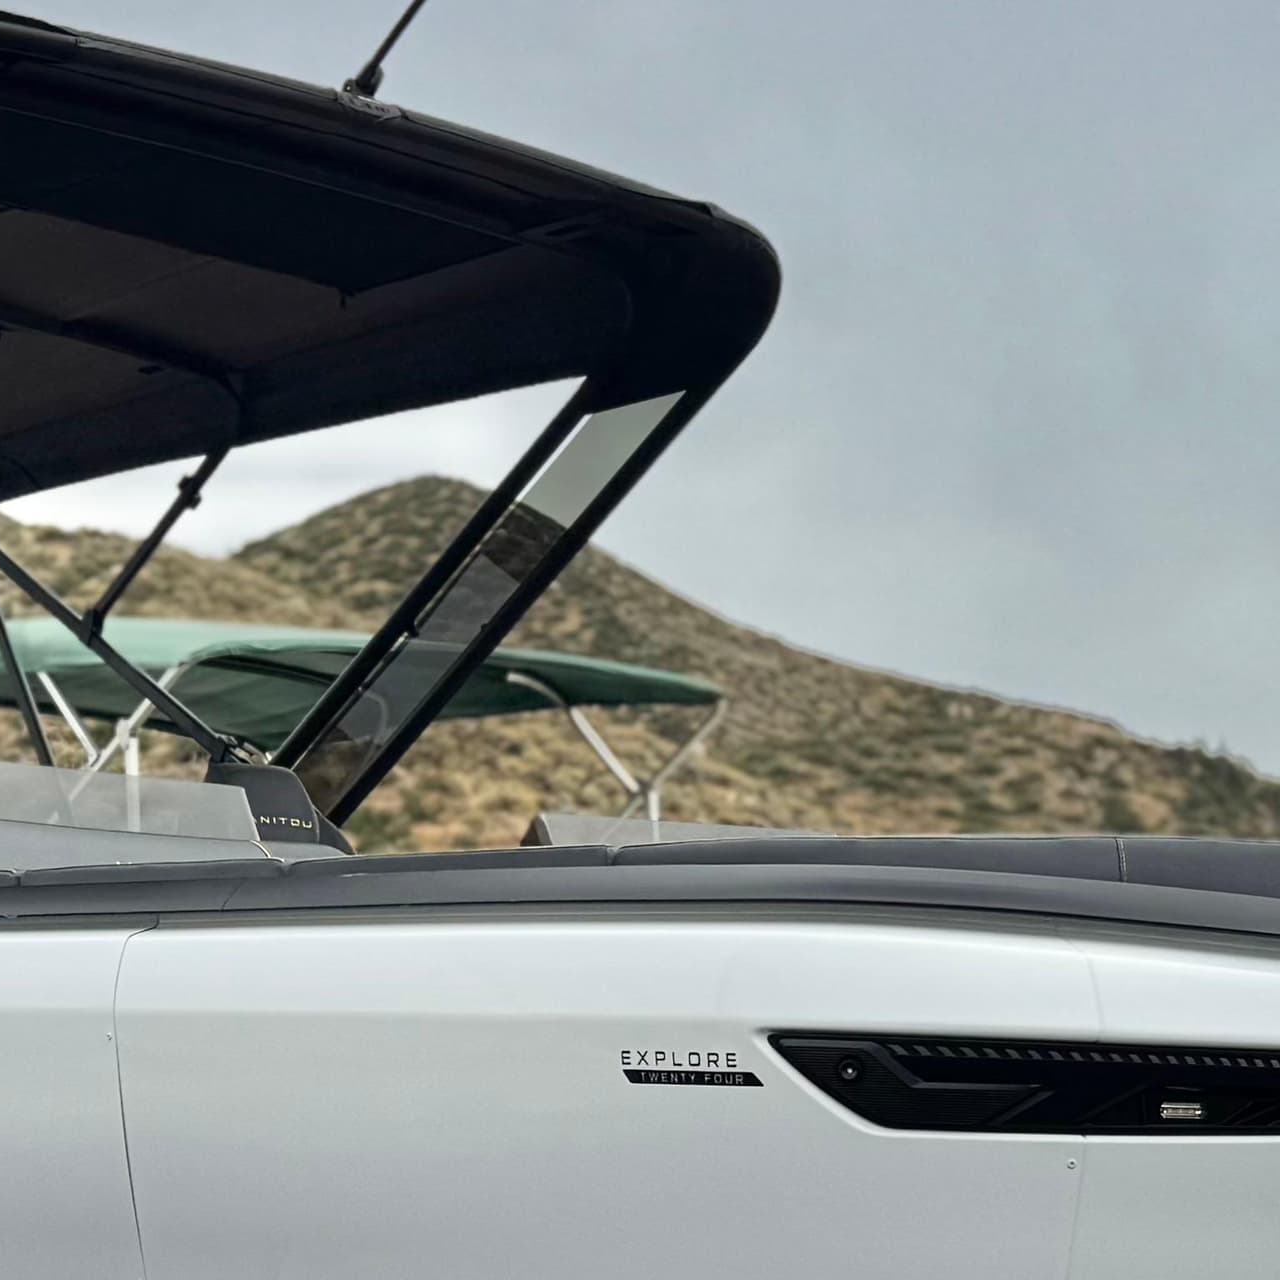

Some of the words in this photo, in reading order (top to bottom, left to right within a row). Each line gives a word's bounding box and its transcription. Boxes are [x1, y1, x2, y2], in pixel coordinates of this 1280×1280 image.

[256, 815, 313, 829] NITOU
[620, 1050, 737, 1068] EXPLORE
[640, 1071, 696, 1084] TWENTY
[704, 1072, 745, 1086] FOUR
